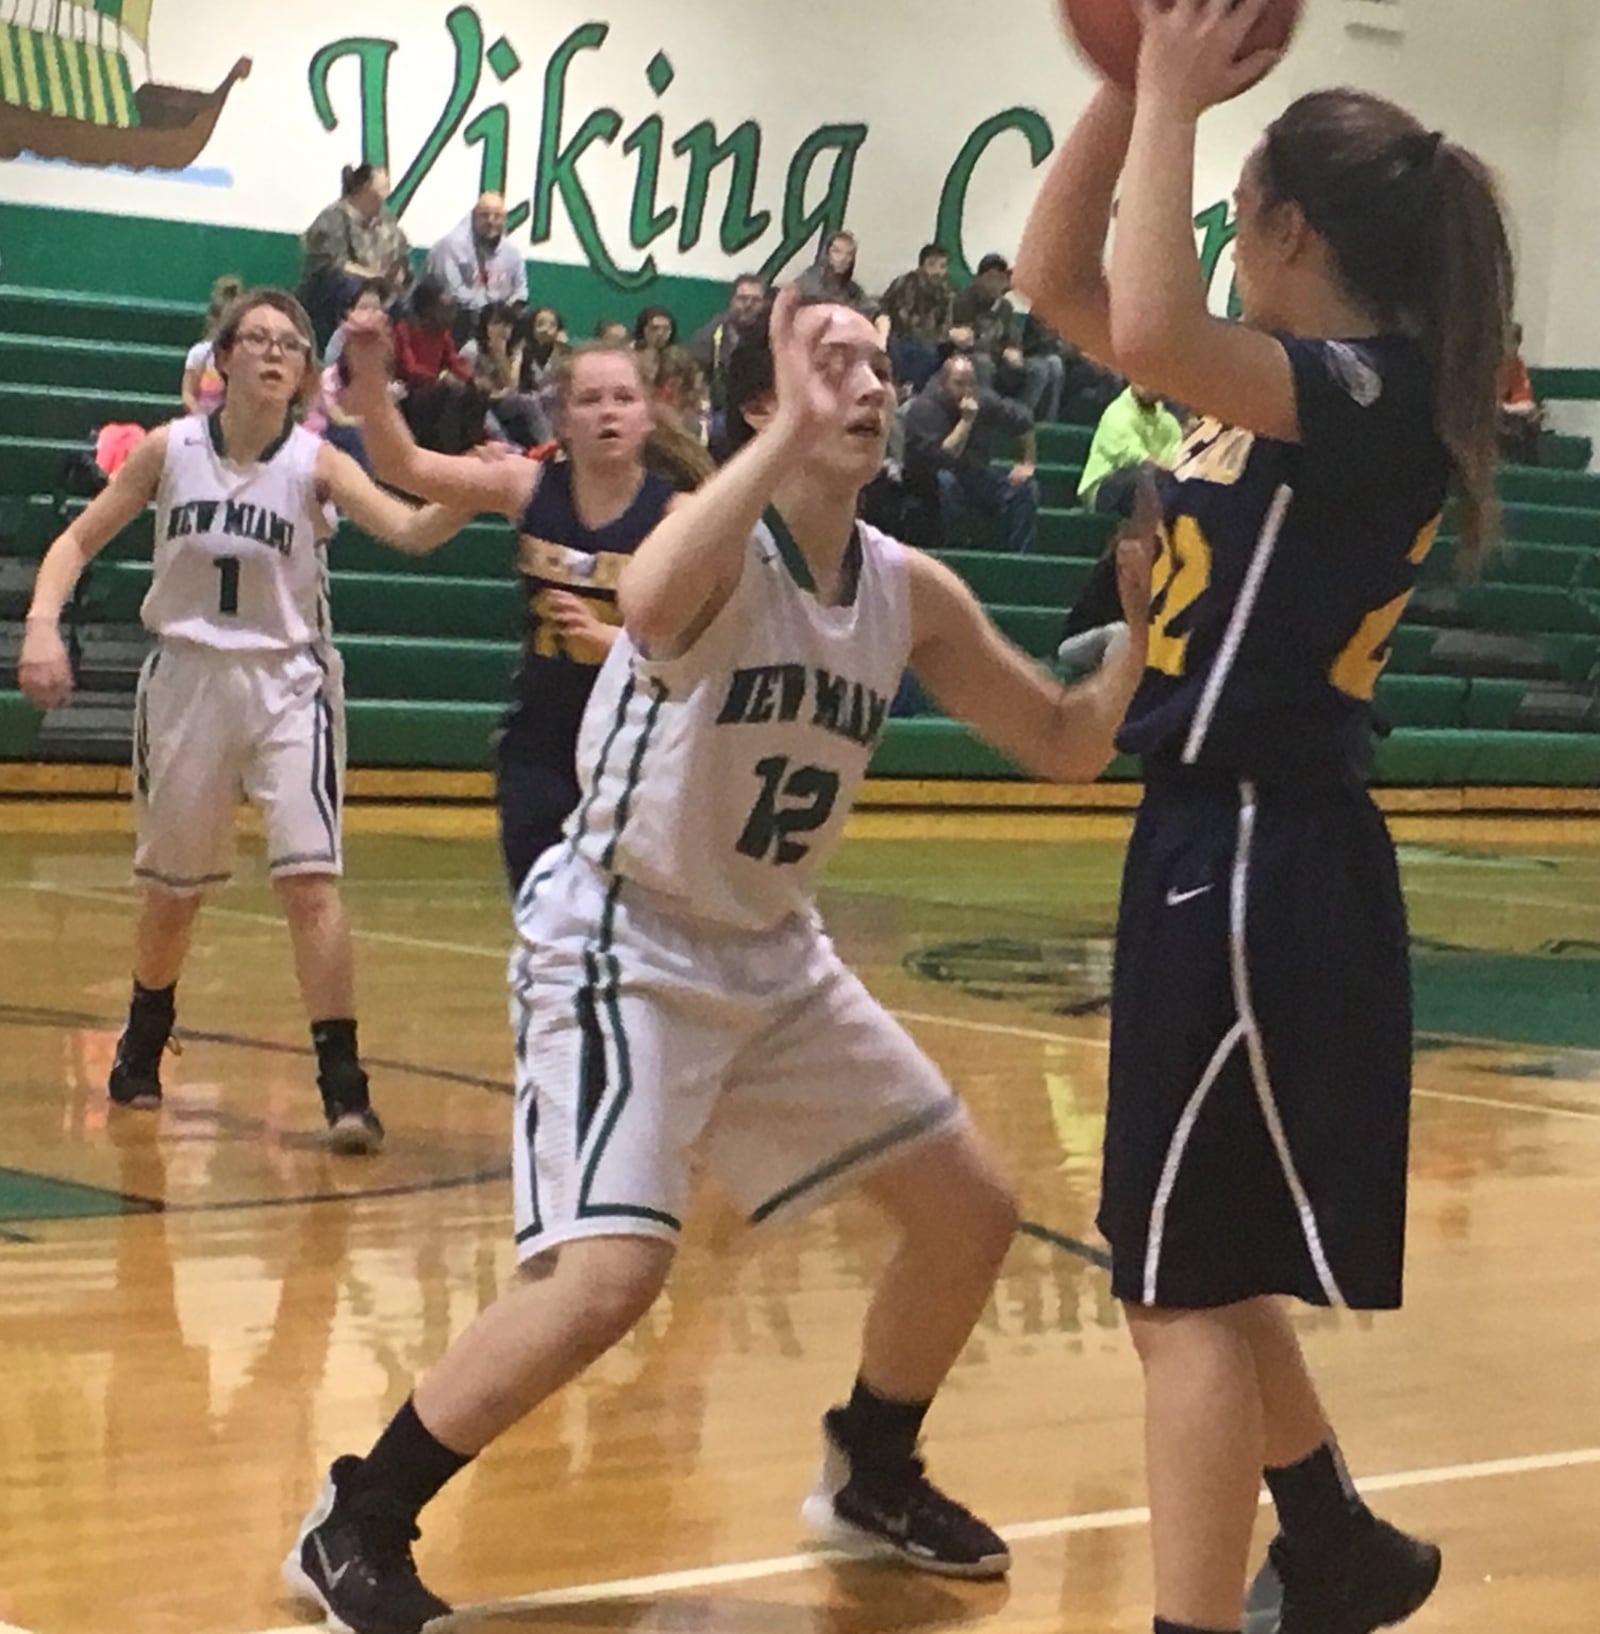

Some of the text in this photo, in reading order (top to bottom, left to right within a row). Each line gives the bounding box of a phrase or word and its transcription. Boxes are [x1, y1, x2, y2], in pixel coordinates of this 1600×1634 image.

[308, 4, 868, 289] Viking
[166, 500, 221, 542] NEW
[212, 554, 241, 616] 1
[715, 663, 806, 726] NEW
[735, 754, 840, 865] 12
